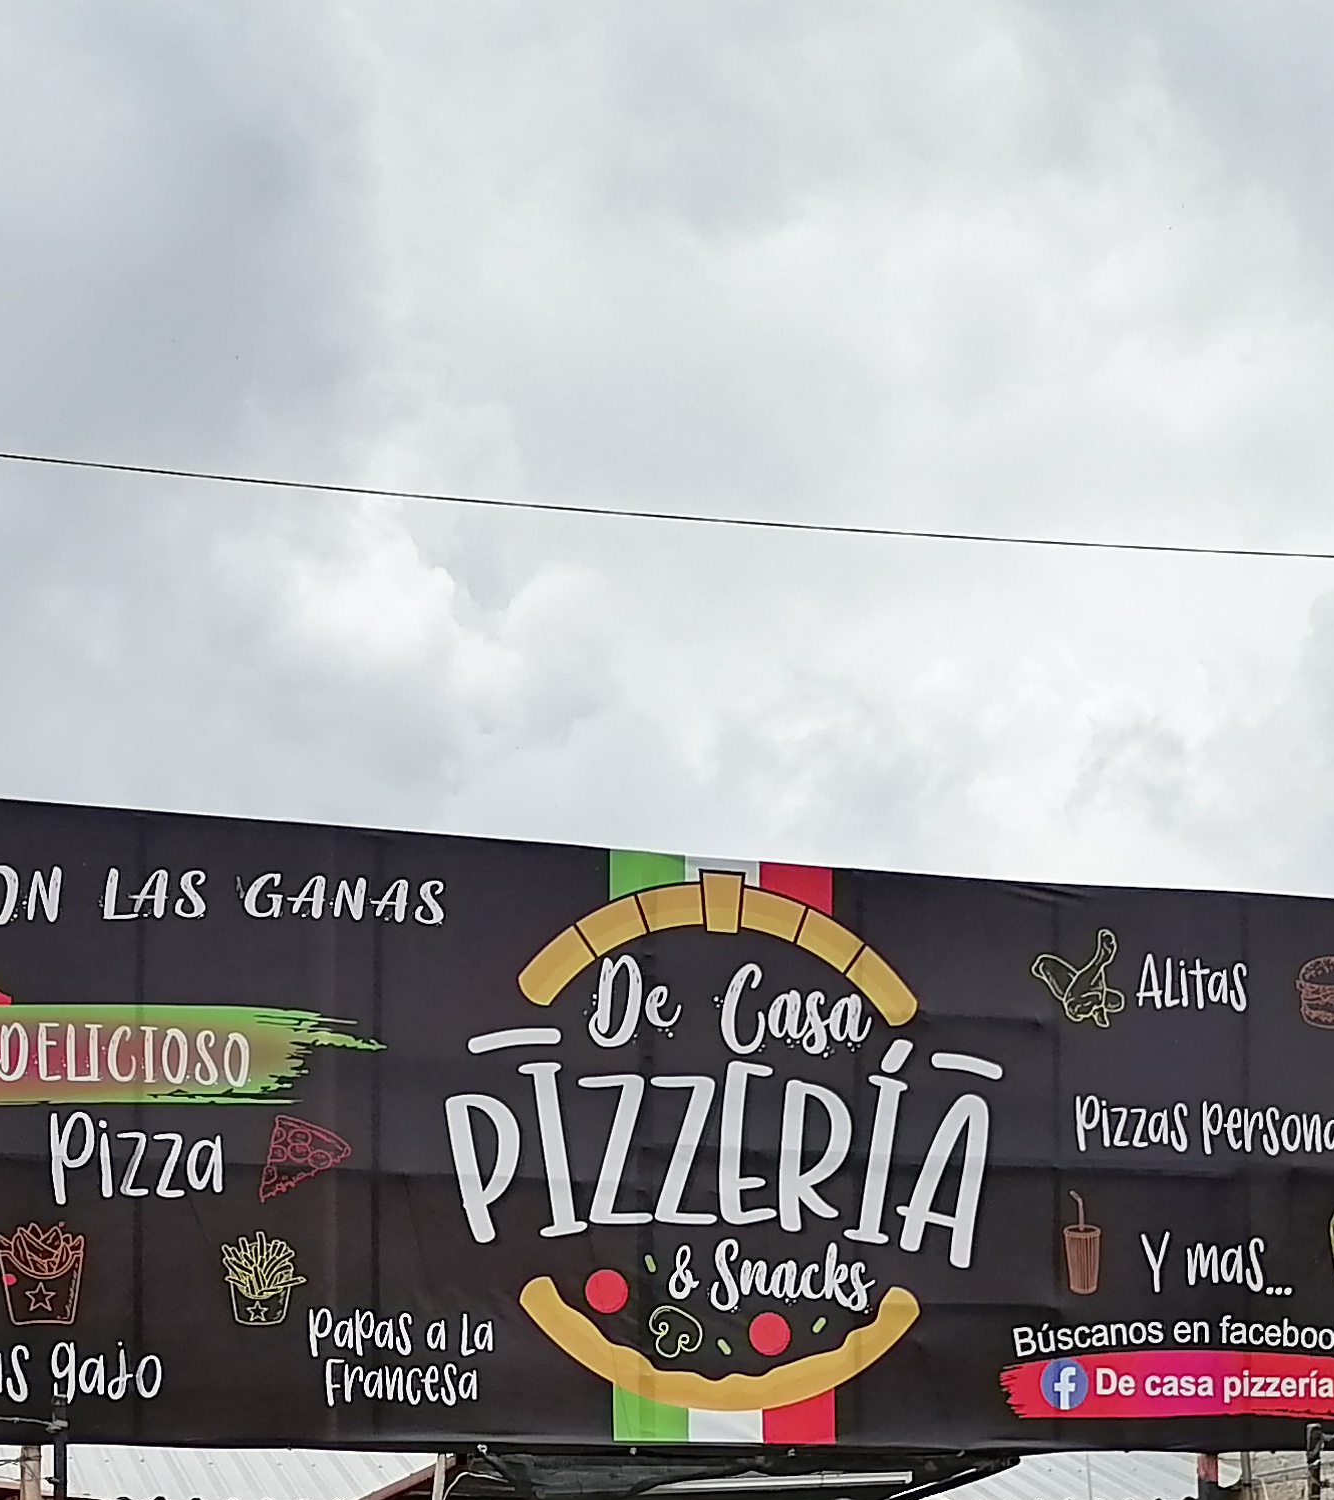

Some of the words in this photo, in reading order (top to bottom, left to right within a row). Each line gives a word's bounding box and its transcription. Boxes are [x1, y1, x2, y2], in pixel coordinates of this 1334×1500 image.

[102, 868, 208, 920] LAS
[243, 873, 446, 926] GANAS
[588, 954, 681, 1048] De
[719, 961, 873, 1056] Casa
[445, 1037, 990, 1270] PIZZERÍA
[1074, 1094, 1189, 1154] Pizzas
[51, 1111, 225, 1206] Pizza
[668, 1244, 700, 1301] &
[709, 1237, 876, 1313] Snacks
[1140, 1230, 1170, 1294] Y
[308, 1307, 414, 1360] Papas
[425, 1319, 446, 1352] a
[1013, 1313, 1165, 1356] Búscanos
[1173, 1321, 1211, 1347] en
[51, 1340, 163, 1404] gajo
[325, 1358, 479, 1408] Francesa
[1094, 1366, 1138, 1398] De
[1143, 1372, 1215, 1399] casa
